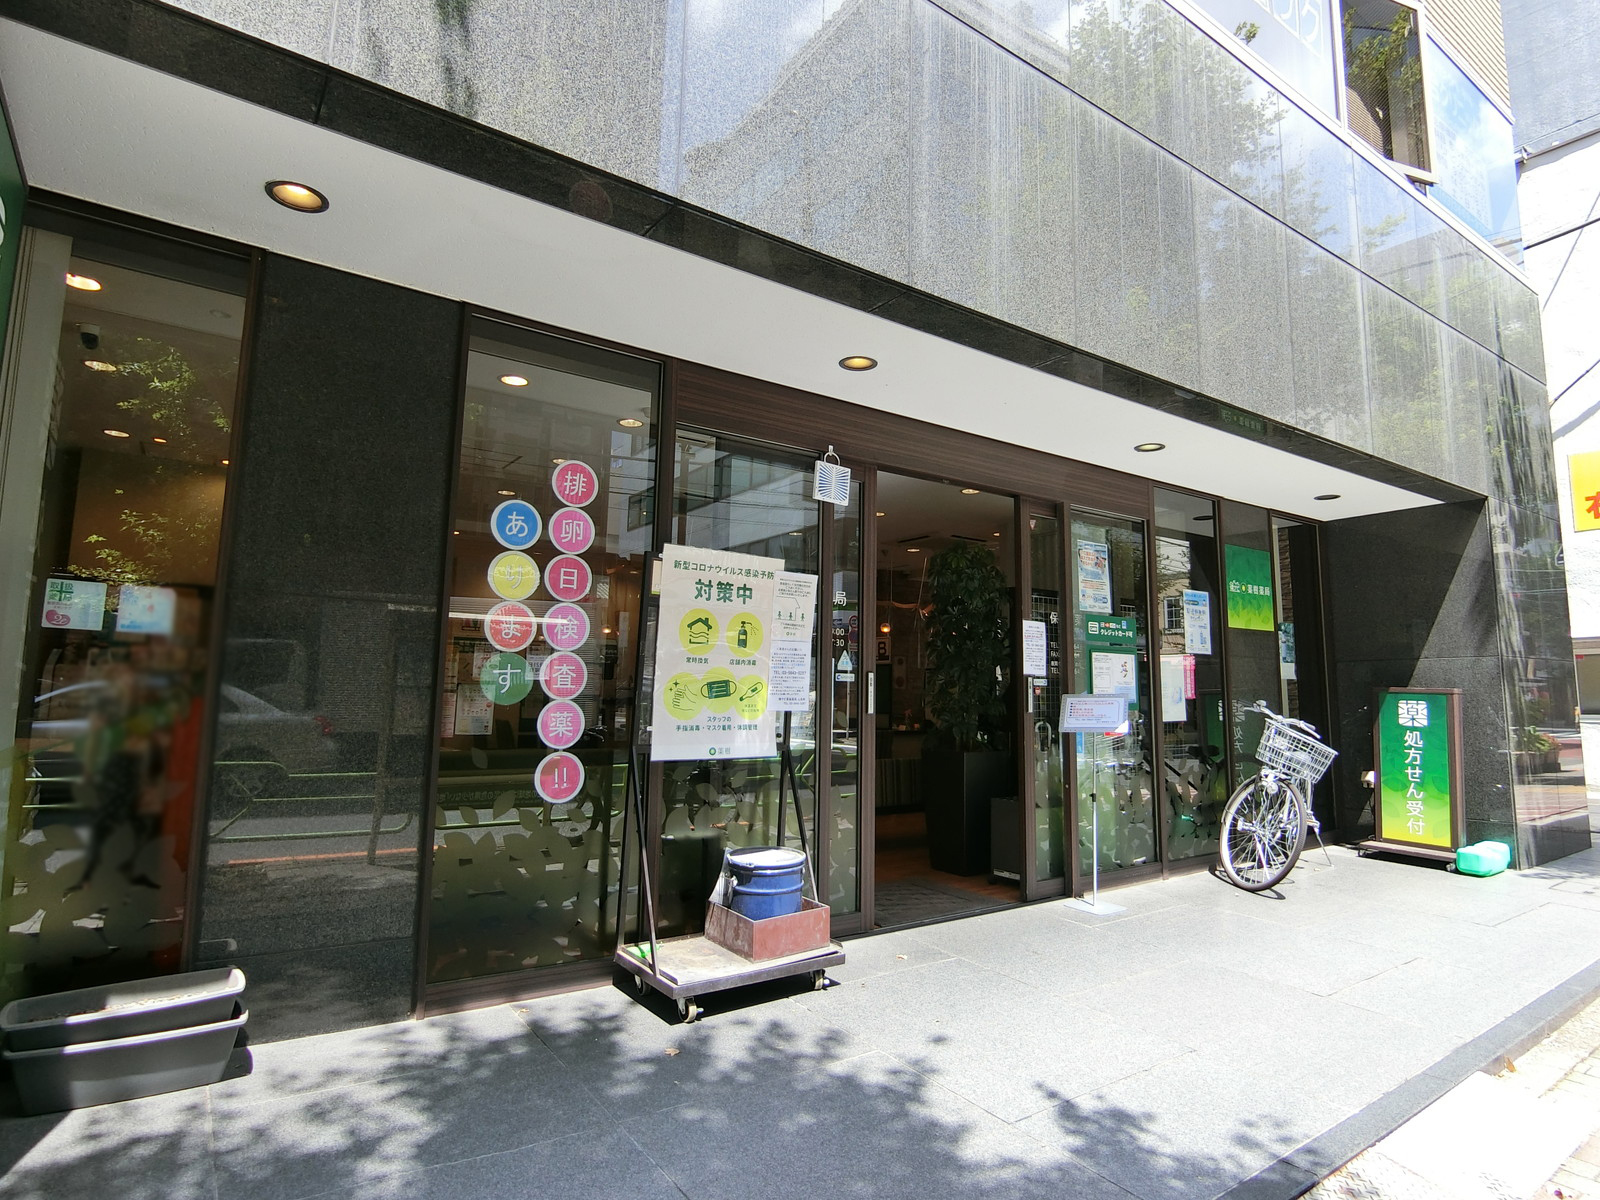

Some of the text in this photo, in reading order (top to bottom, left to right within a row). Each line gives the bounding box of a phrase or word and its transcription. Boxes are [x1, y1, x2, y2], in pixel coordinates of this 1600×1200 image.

[493, 511, 529, 695] あります
[673, 559, 775, 581] 新型コロナウイルス感染予防
[694, 578, 754, 606] 対策中
[1403, 730, 1425, 836] 処方せん受付
